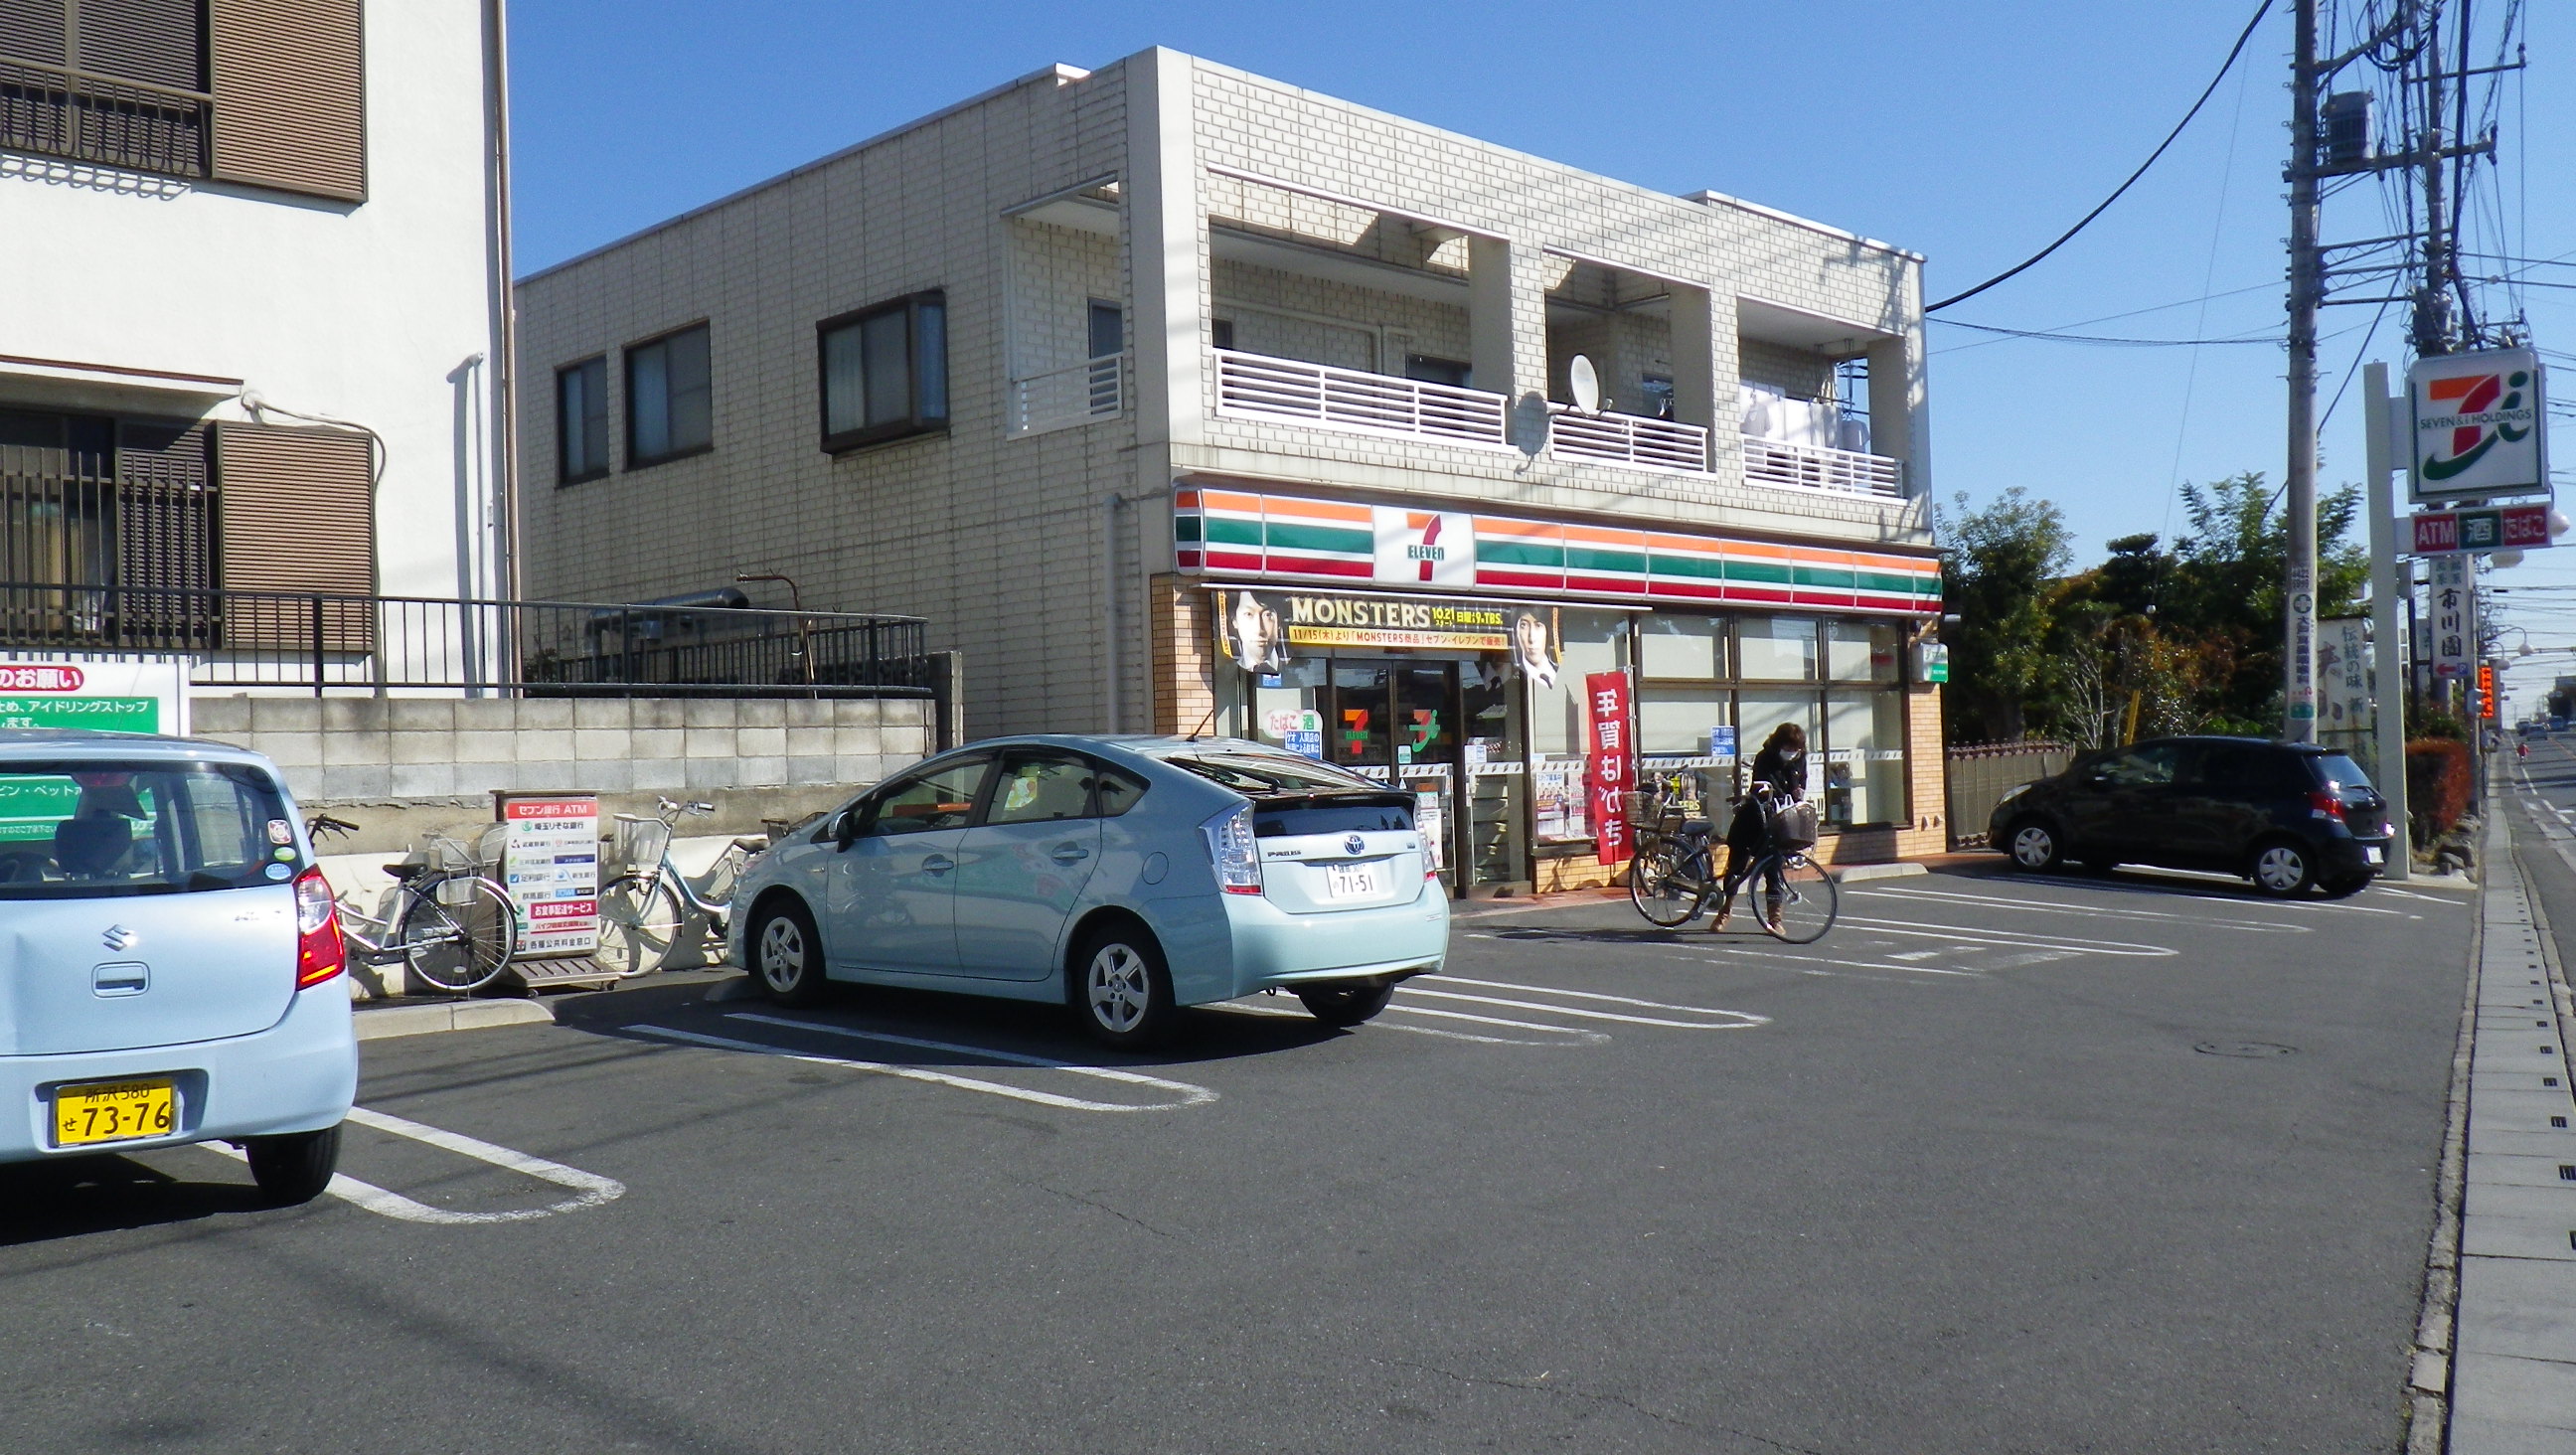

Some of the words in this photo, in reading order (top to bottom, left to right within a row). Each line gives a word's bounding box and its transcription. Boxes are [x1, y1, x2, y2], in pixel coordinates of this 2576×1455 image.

[2472, 408, 2532, 423] HOLDINGS
[2417, 520, 2456, 546] ATM
[2504, 514, 2546, 539] たばこ
[1291, 596, 1431, 628] MONSTERS
[1432, 607, 1455, 620] 10.21
[0, 668, 80, 689] のお願い
[1270, 715, 1298, 730] たばこ
[519, 805, 561, 815] セブン銀行
[564, 804, 587, 814] ATM
[1340, 875, 1373, 893] 71-51
[121, 1083, 150, 1100] 580
[63, 1117, 78, 1132] せ
[82, 1101, 170, 1136] 73-76
